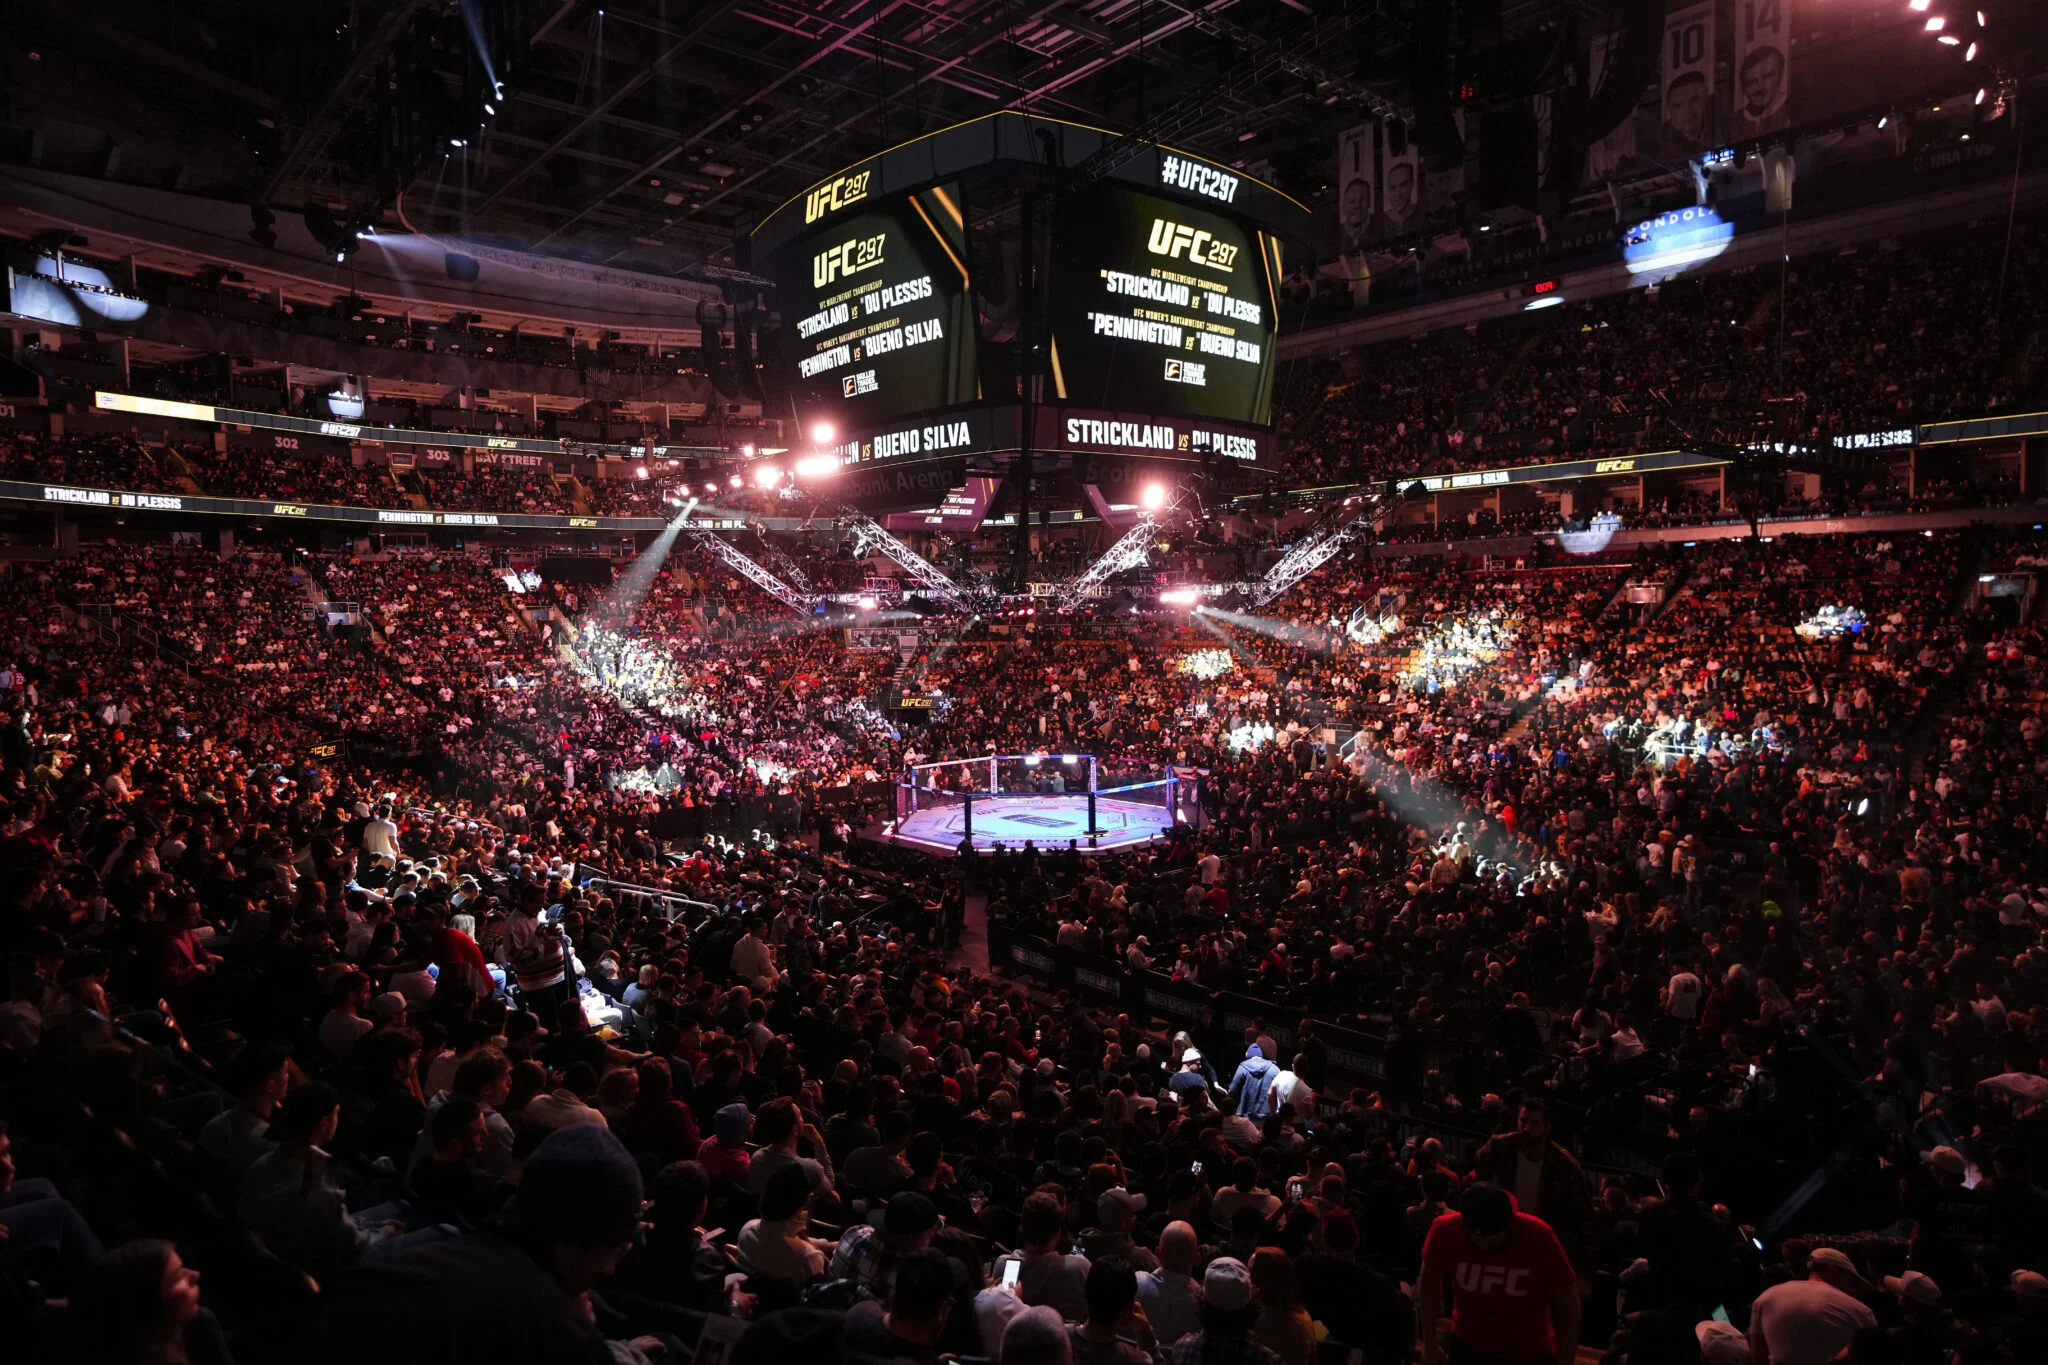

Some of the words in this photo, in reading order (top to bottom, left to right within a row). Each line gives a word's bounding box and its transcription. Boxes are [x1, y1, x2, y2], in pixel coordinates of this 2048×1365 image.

[1672, 23, 1705, 69] 10
[1161, 156, 1239, 203] #UFC297
[805, 176, 845, 224] UFC
[843, 170, 871, 200] 297
[1148, 218, 1212, 265] UFC
[1209, 240, 1238, 267] 297
[1561, 228, 1616, 249] MEDIA
[813, 238, 858, 289] UFC
[857, 233, 886, 263] 297
[799, 303, 849, 339] STRICKLAND
[864, 291, 881, 315] DU
[881, 275, 933, 309] PLESSIS
[1106, 270, 1190, 306] STRICKLAND
[1207, 292, 1223, 314] DU
[1223, 296, 1261, 324] PLESSIS
[800, 344, 851, 379] PENNINGTON
[865, 328, 904, 357] BUENO
[904, 318, 943, 347] SILVA
[1094, 313, 1183, 347] PENNINGTON
[1200, 332, 1235, 358] BUENO
[1235, 340, 1261, 364] SILVA
[320, 422, 361, 438] #UFC297
[862, 444, 871, 456] VS
[874, 429, 920, 459] BUENO
[923, 421, 971, 451] SILVA
[1066, 418, 1174, 450] STRICKLAND
[1178, 434, 1189, 447] VS
[1192, 430, 1210, 452] DU
[1212, 434, 1257, 461] PLESSIS
[274, 436, 299, 450] 302
[488, 438, 508, 448] UFC
[427, 449, 450, 461] 303
[501, 454, 543, 466] STREET
[1596, 460, 1622, 472] UFC
[1482, 471, 1510, 485] SILVA
[44, 487, 110, 504] STRICKLAND
[121, 495, 136, 507] DU
[138, 496, 182, 509] PLESSIS
[273, 504, 297, 516] UFC
[378, 511, 434, 523] PENNINGTON
[444, 514, 473, 524] BUENO
[474, 514, 499, 525] SILVA
[569, 518, 589, 527] UFC
[901, 698, 922, 707] UFC
[1455, 1261, 1531, 1297] UFC
